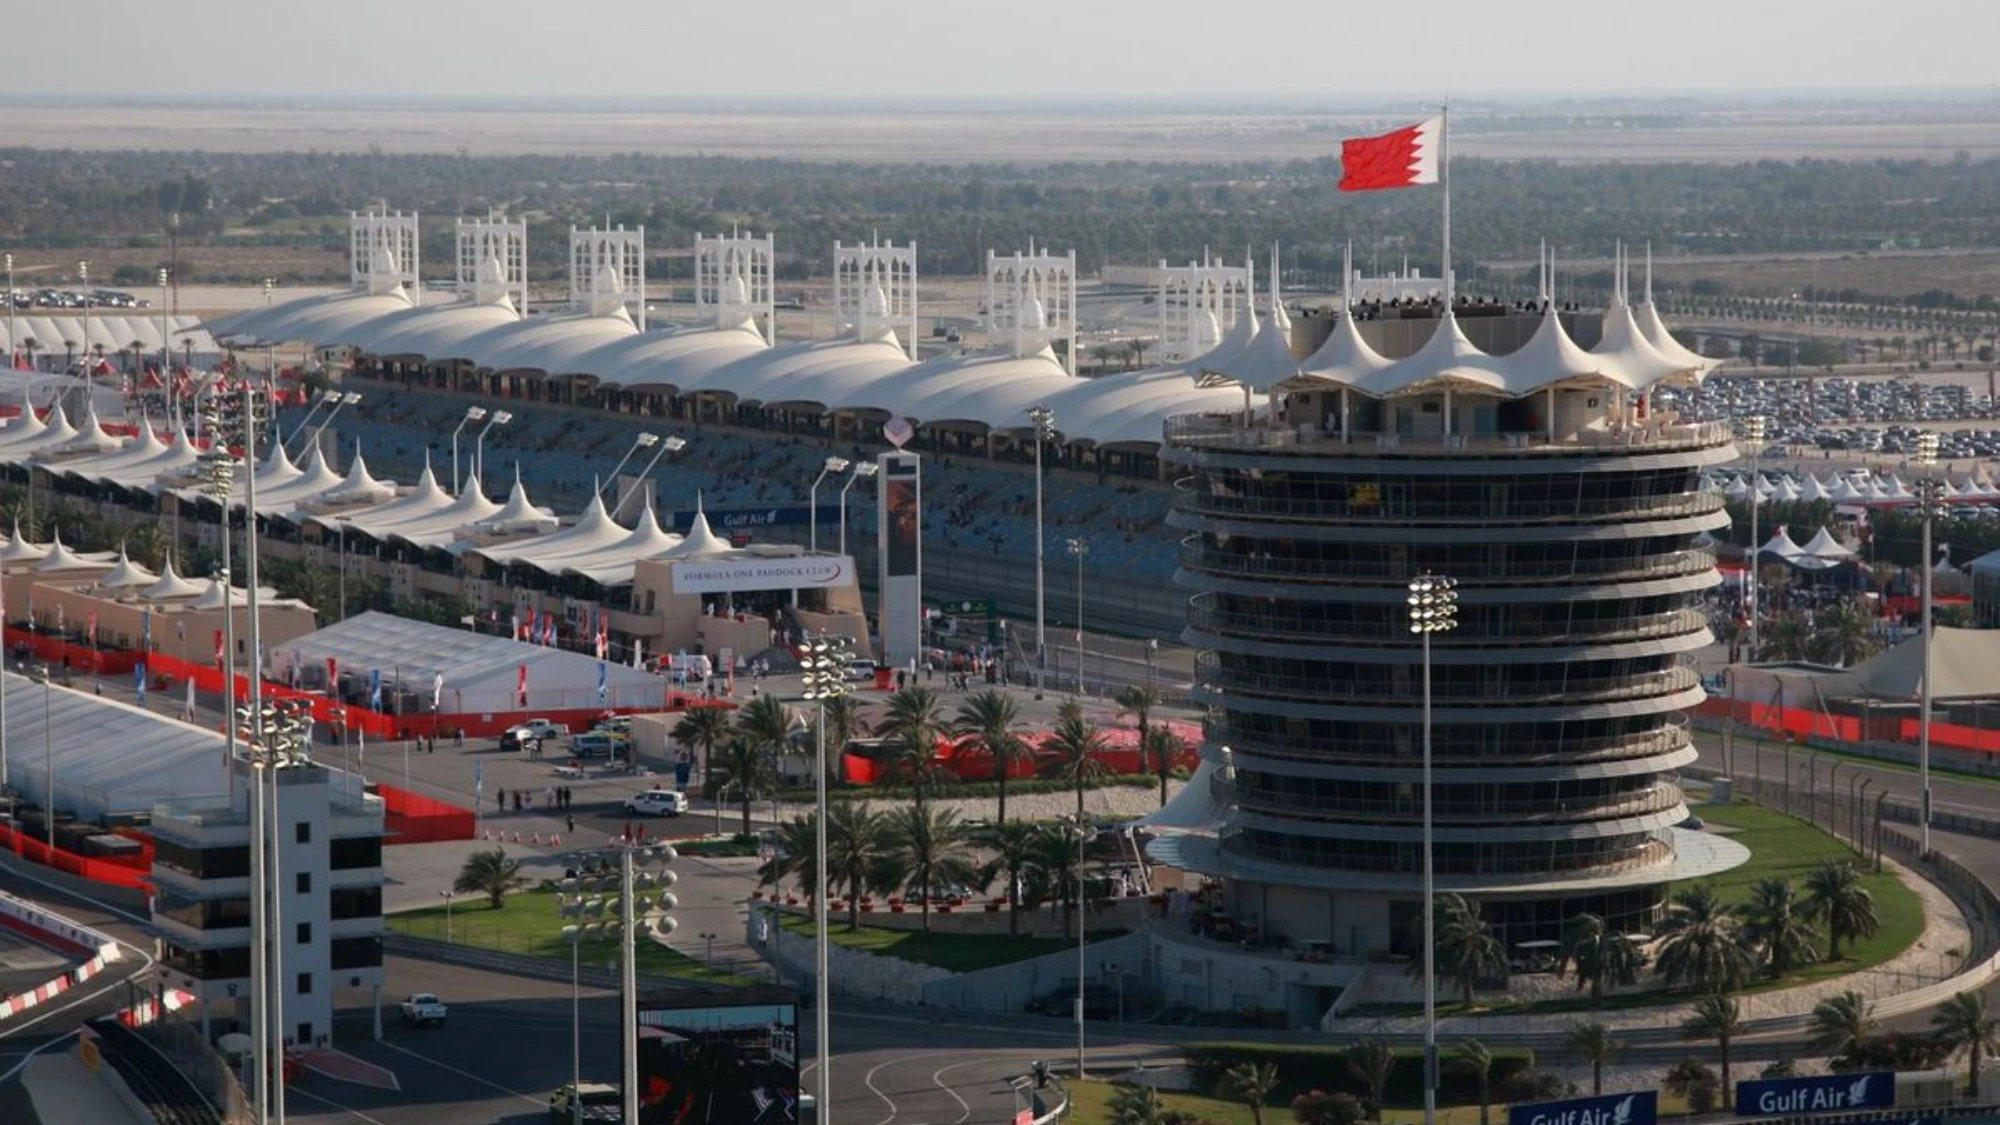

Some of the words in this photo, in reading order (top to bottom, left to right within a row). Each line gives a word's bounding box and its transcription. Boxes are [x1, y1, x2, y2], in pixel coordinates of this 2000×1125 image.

[724, 512, 748, 526] Gulf
[749, 513, 766, 525] Air
[684, 571, 731, 582] FORMULA
[733, 570, 753, 579] ONE
[757, 568, 802, 578] PADDOCK
[806, 567, 831, 575] CLUB
[1760, 1088, 1808, 1113] Gulf
[1811, 1087, 1845, 1110] Air
[1530, 1110, 1577, 1125] Gulf
[1581, 1108, 1611, 1125] Air
